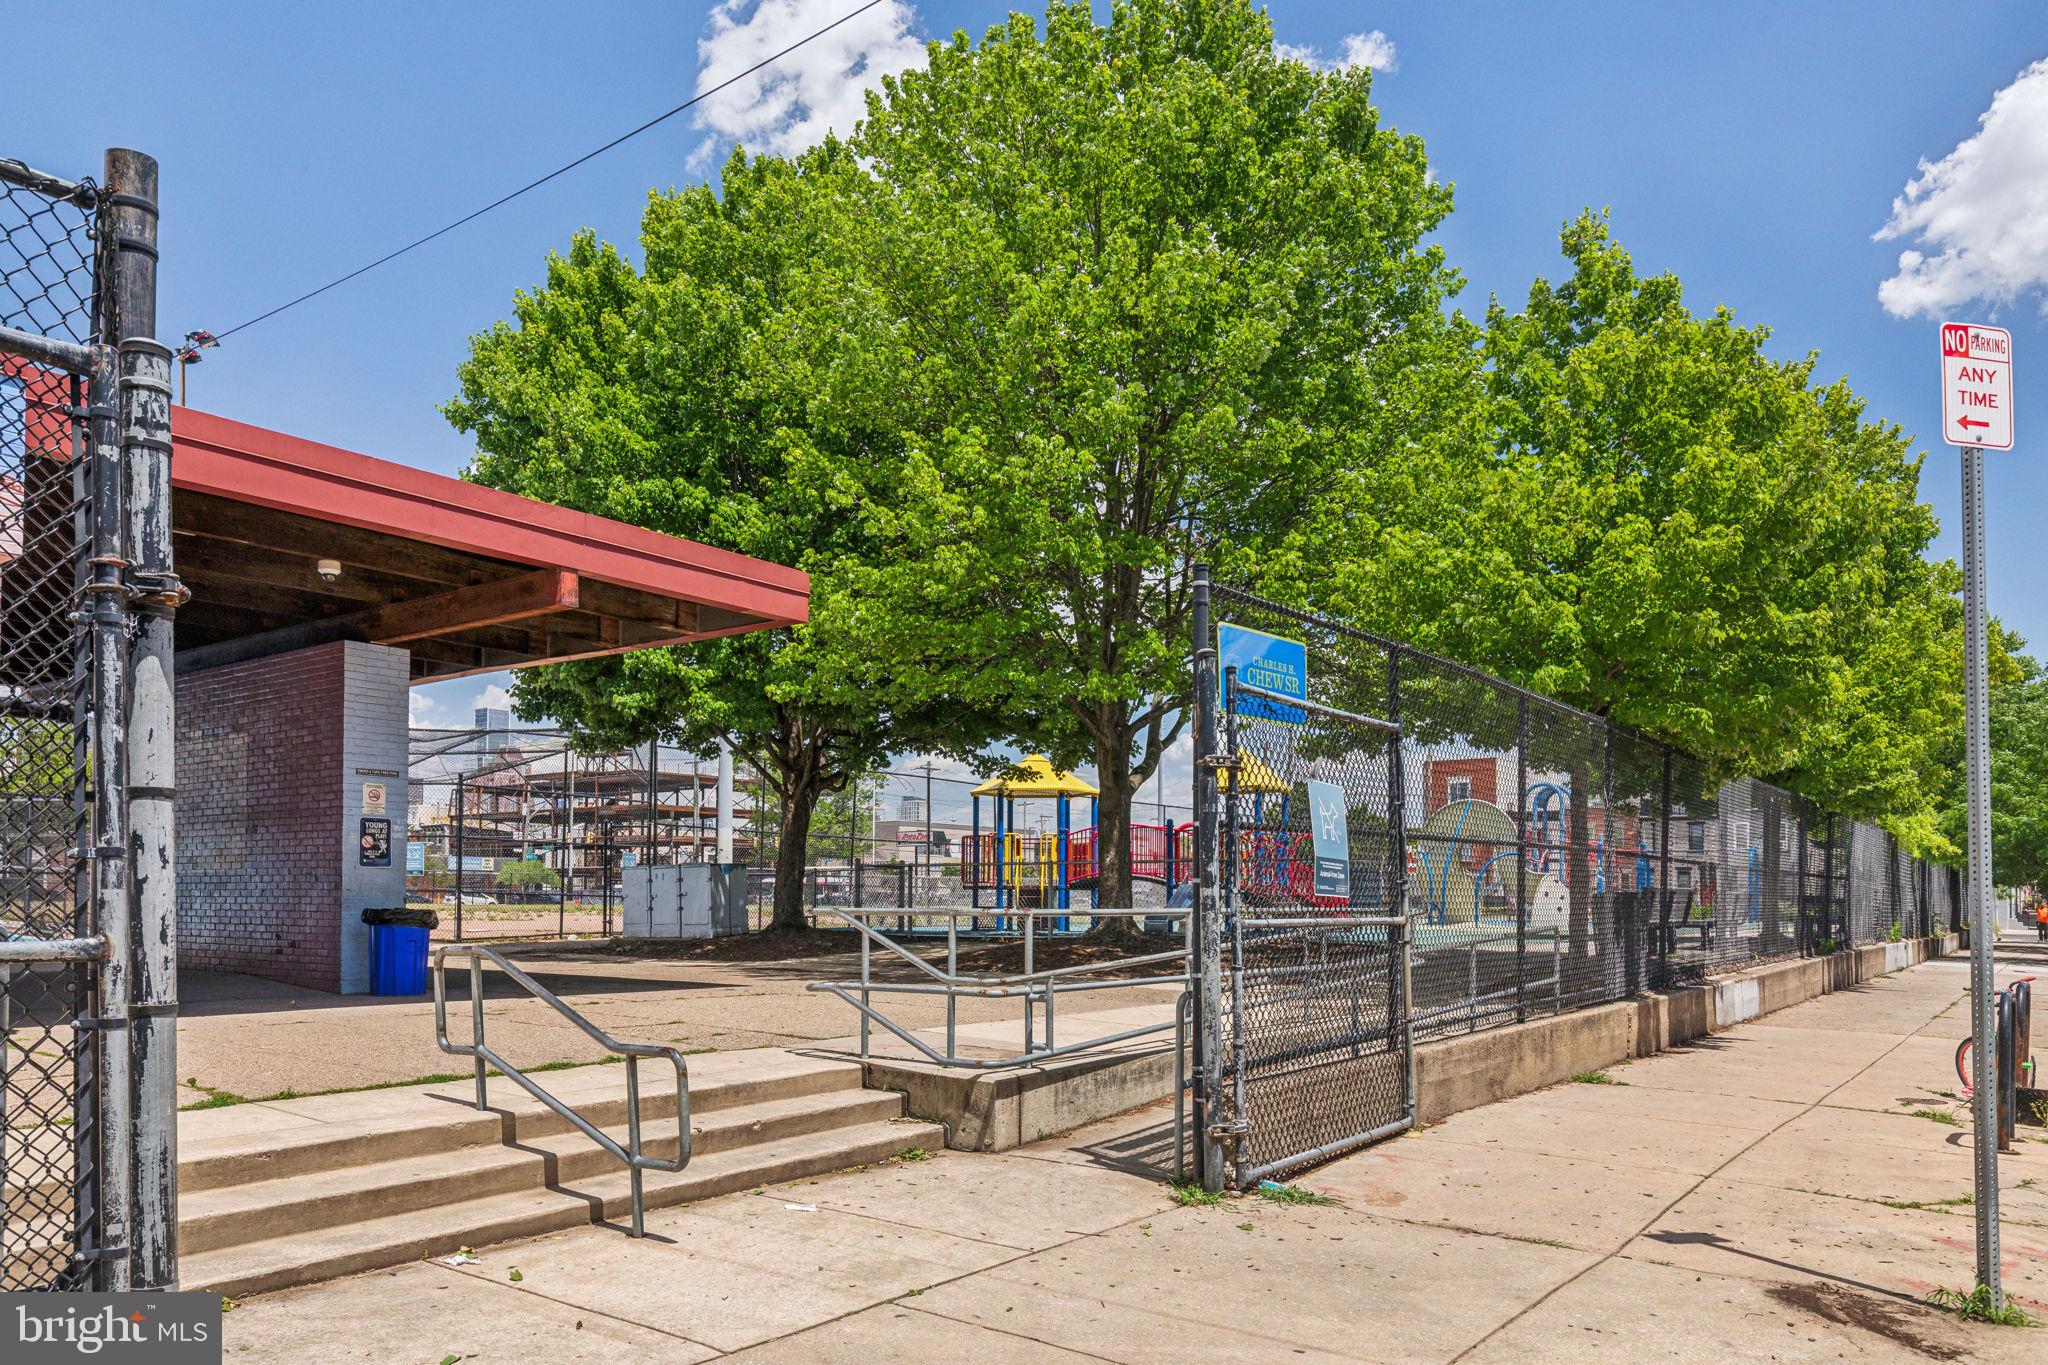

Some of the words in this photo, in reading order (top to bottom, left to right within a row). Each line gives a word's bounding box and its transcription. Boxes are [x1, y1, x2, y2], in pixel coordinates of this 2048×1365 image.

[1944, 328, 1966, 353] NO
[1970, 334, 2006, 354] PARKING
[1958, 366, 1997, 384] ANY
[1958, 390, 1999, 409] TIME
[1252, 655, 1287, 673] CHARLES
[1288, 664, 1296, 675] H.
[365, 821, 388, 829] YOUNG
